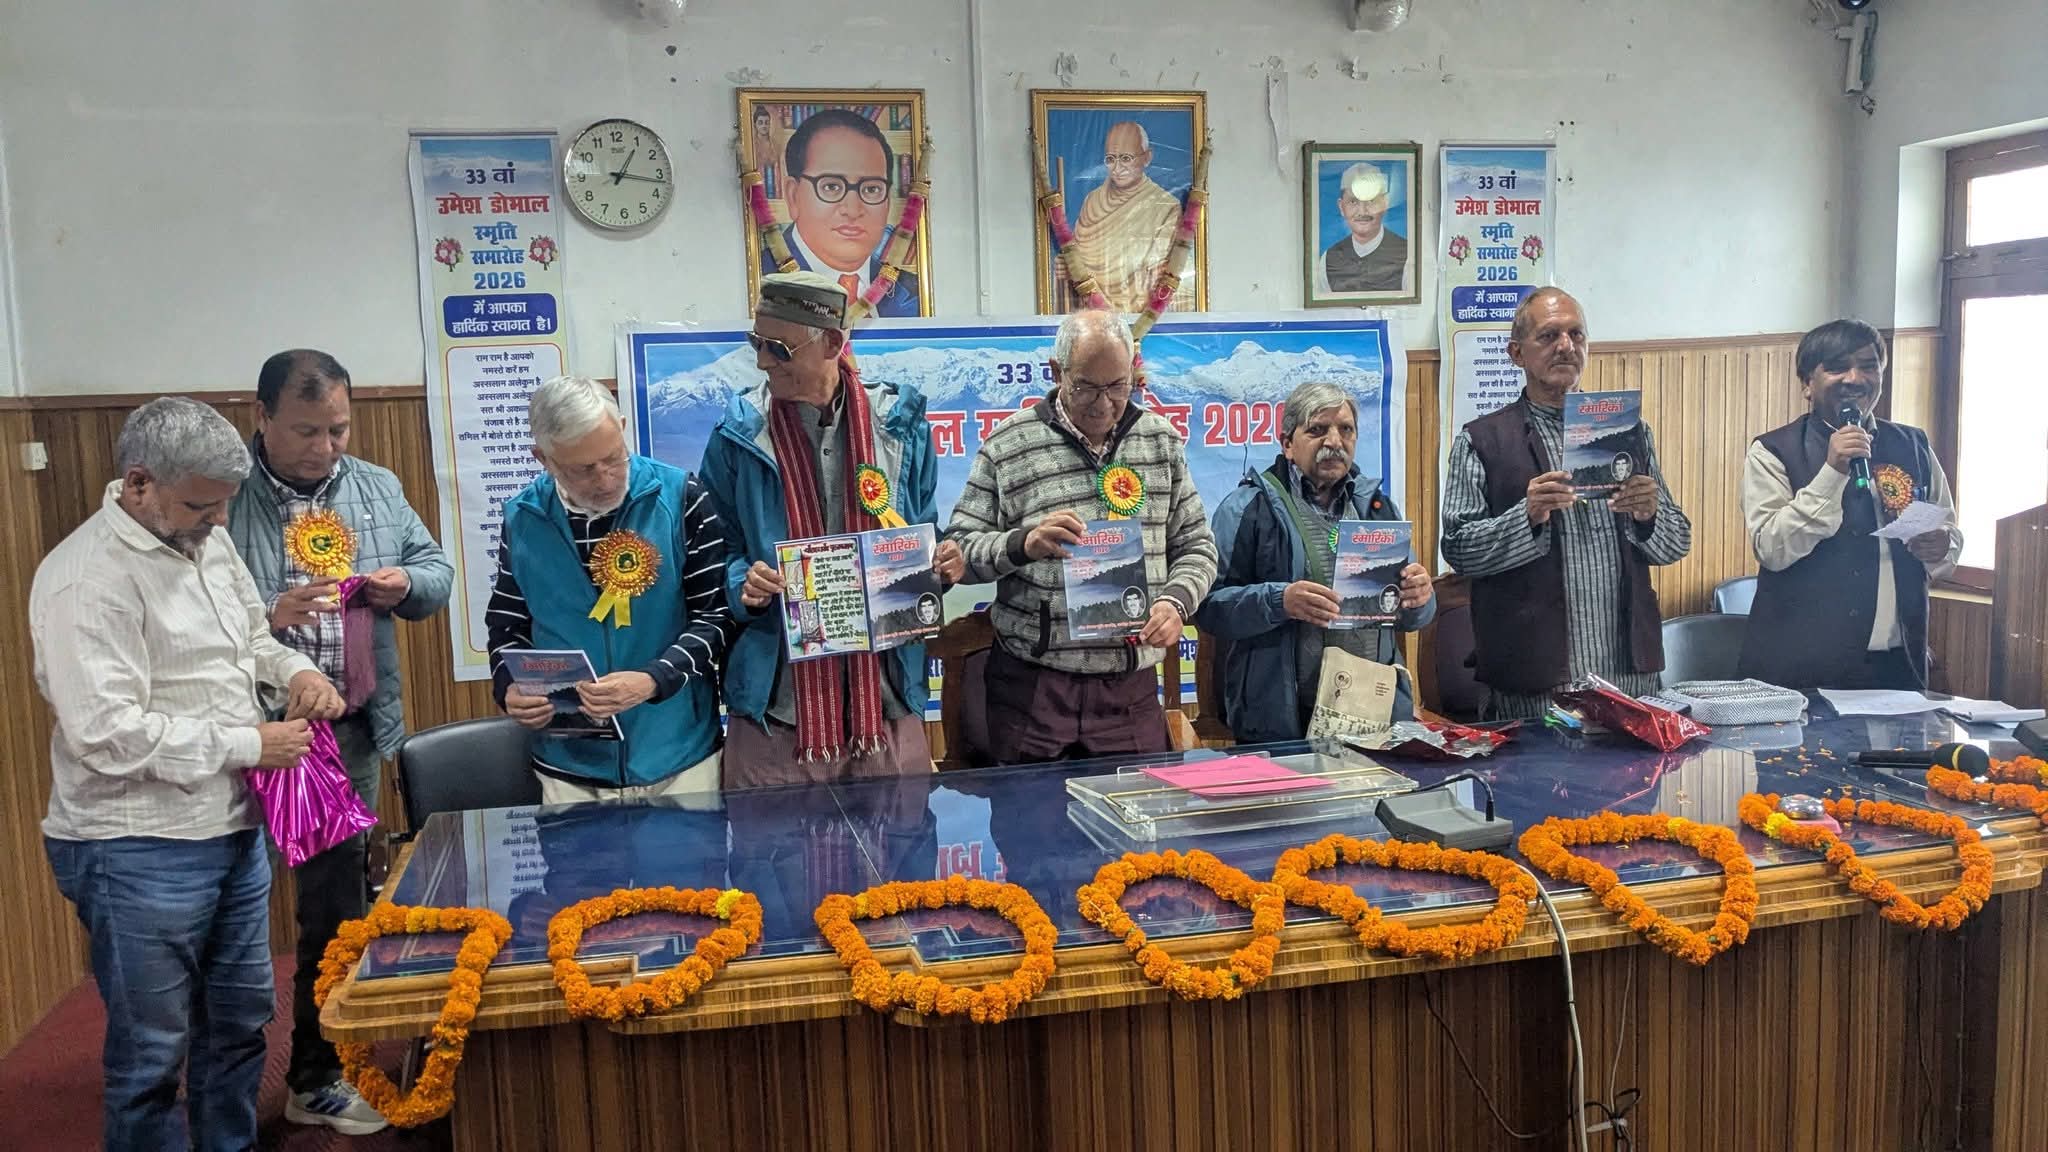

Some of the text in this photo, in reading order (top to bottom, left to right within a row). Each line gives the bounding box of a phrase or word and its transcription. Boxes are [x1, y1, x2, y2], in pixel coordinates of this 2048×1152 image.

[592, 137, 603, 149] 11
[610, 131, 623, 142] 12
[634, 136, 640, 147] 1
[580, 152, 593, 163] 10
[648, 149, 657, 160] 2
[465, 161, 516, 184] 33 वां
[577, 171, 586, 182] 9
[656, 168, 664, 180] 3
[1478, 170, 1517, 190] 33 वां
[585, 190, 594, 201] 8
[652, 188, 660, 199] 4
[436, 192, 482, 214] उमेश
[601, 203, 609, 214] 7
[639, 202, 648, 214] 5
[1455, 195, 1489, 215] उमेश
[620, 208, 629, 219] 6
[473, 221, 517, 245] स्मृति
[1480, 222, 1514, 243] स्मृति
[470, 245, 525, 265] समारोह
[1476, 243, 1519, 260] समारोह
[1477, 266, 1518, 281] 2026
[474, 271, 526, 290] 2026
[1475, 290, 1518, 303] में आपका
[473, 299, 527, 315] में आपका
[1457, 306, 1487, 319] हार्दिक
[452, 317, 489, 334] हार्दिक
[491, 319, 531, 332] स्वागत
[475, 354, 489, 362] राम
[997, 363, 1032, 384] 33
